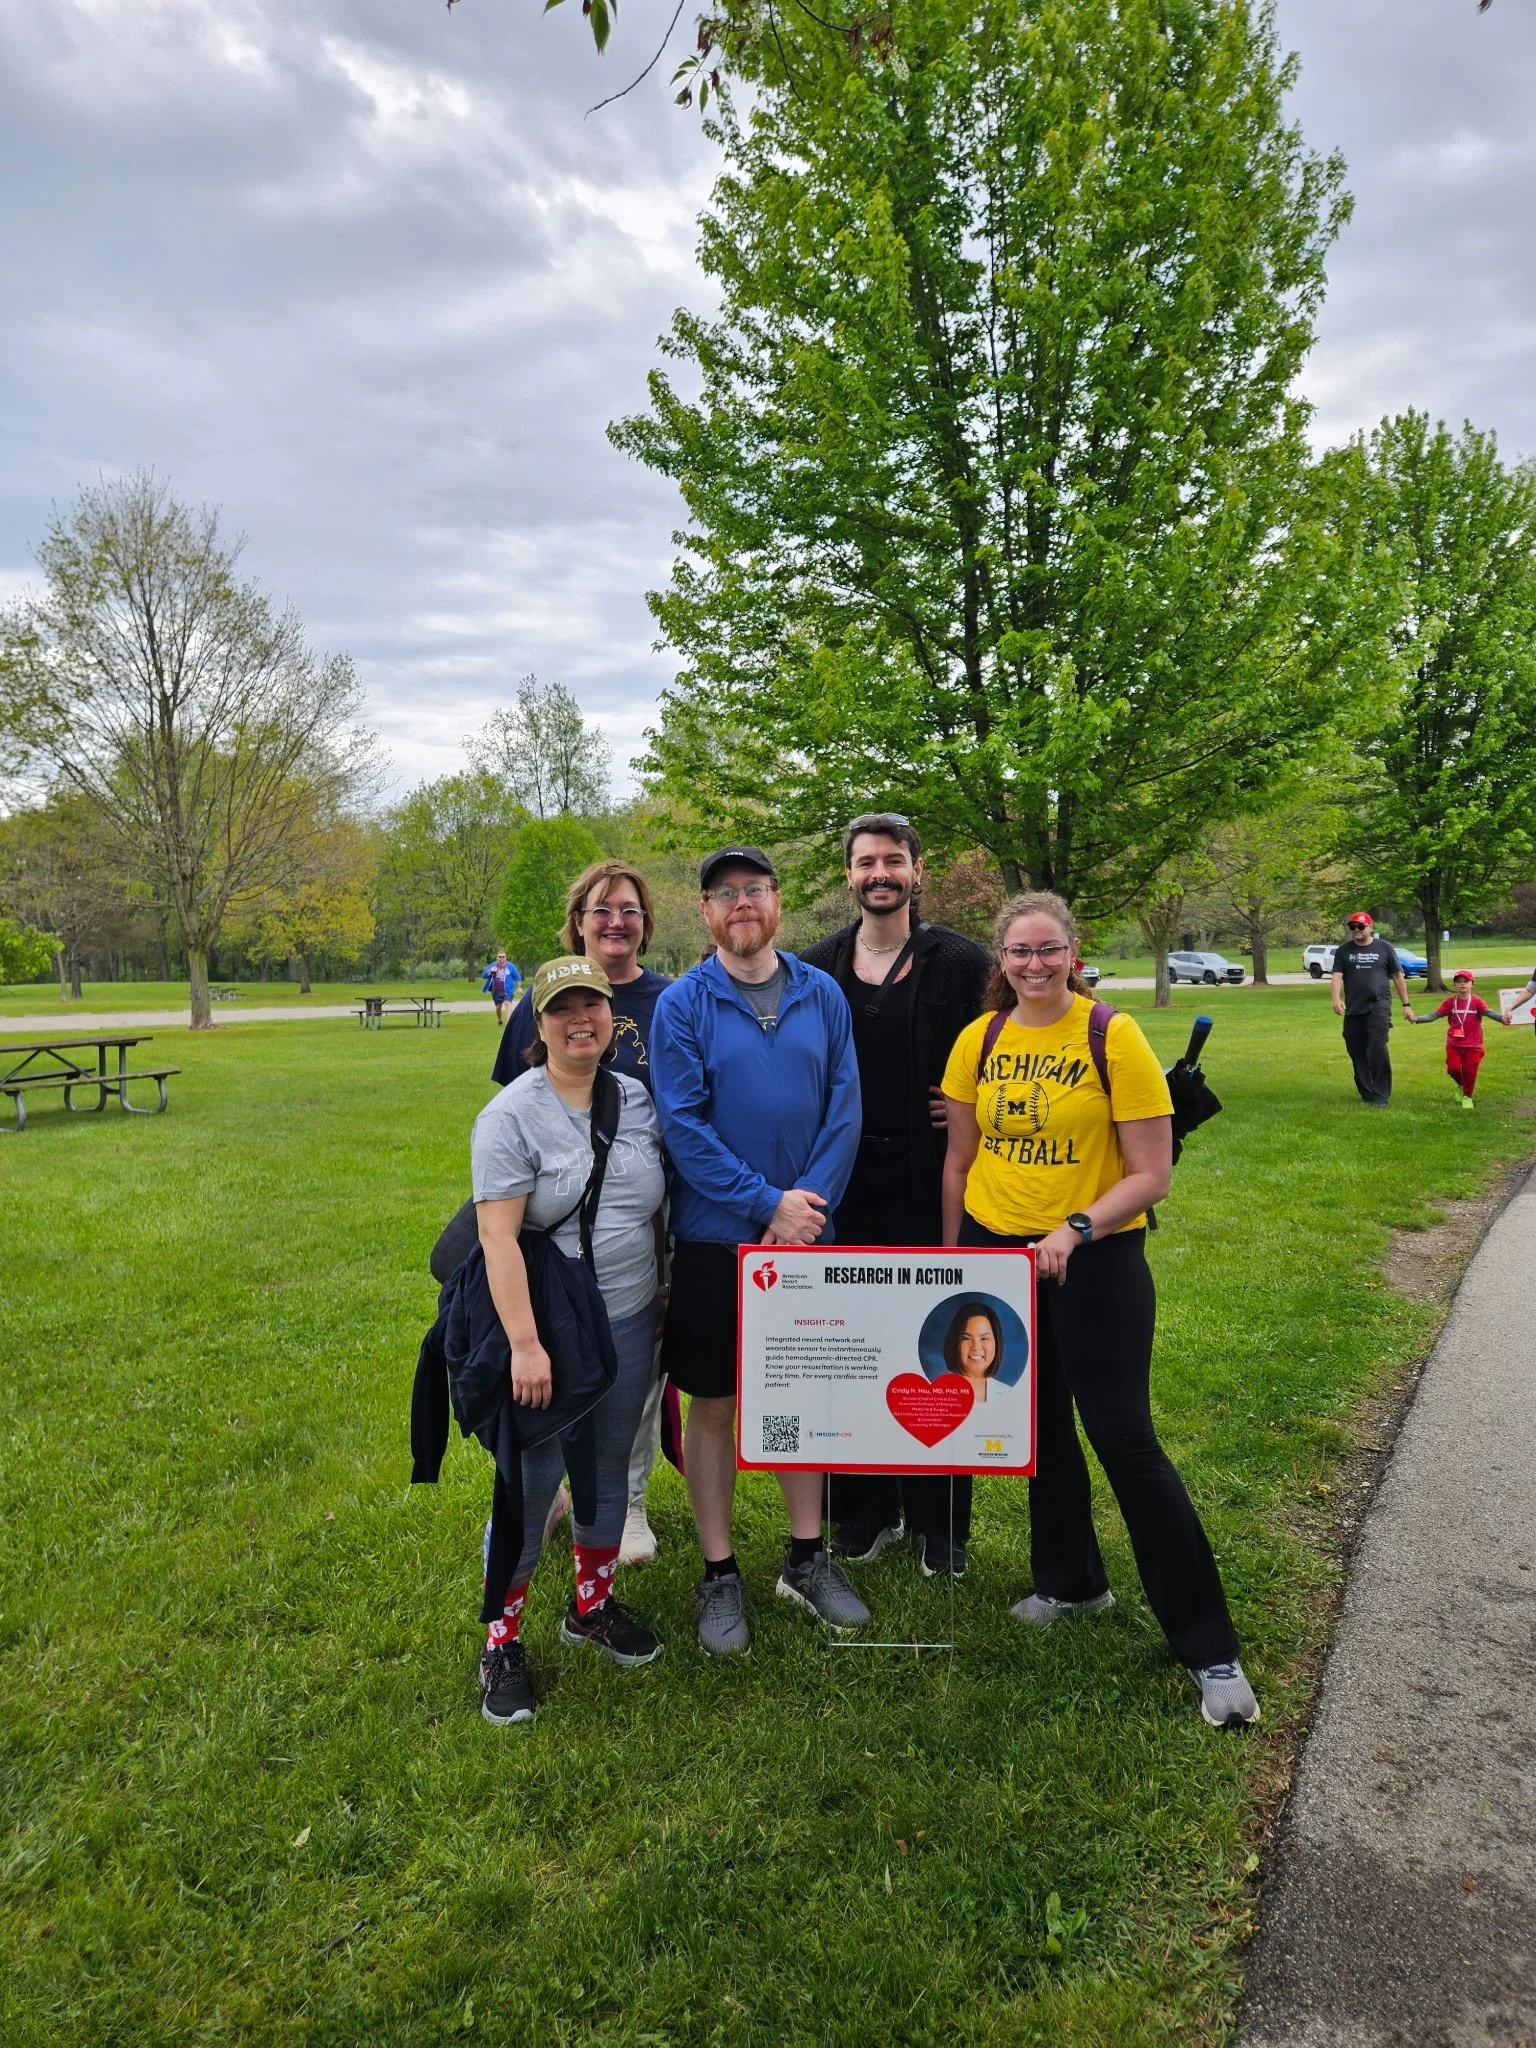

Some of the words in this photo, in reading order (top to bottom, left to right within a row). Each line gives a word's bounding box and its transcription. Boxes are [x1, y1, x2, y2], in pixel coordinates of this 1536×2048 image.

[547, 964, 592, 984] HOPE
[1007, 1100, 1027, 1116] M
[553, 1127, 661, 1196] HPE
[824, 1267, 893, 1285] RESEARCH
[897, 1267, 911, 1285] IN
[915, 1267, 963, 1286] ACTION
[794, 1319, 845, 1327] INSIGHT-CPR
[765, 1336, 801, 1344] Integrated
[827, 1346, 882, 1354] instantaneously
[785, 1354, 862, 1362] hemodynamic-directed
[801, 1363, 844, 1371] resuscitation
[850, 1364, 879, 1372] working.
[985, 1439, 1003, 1452] M
